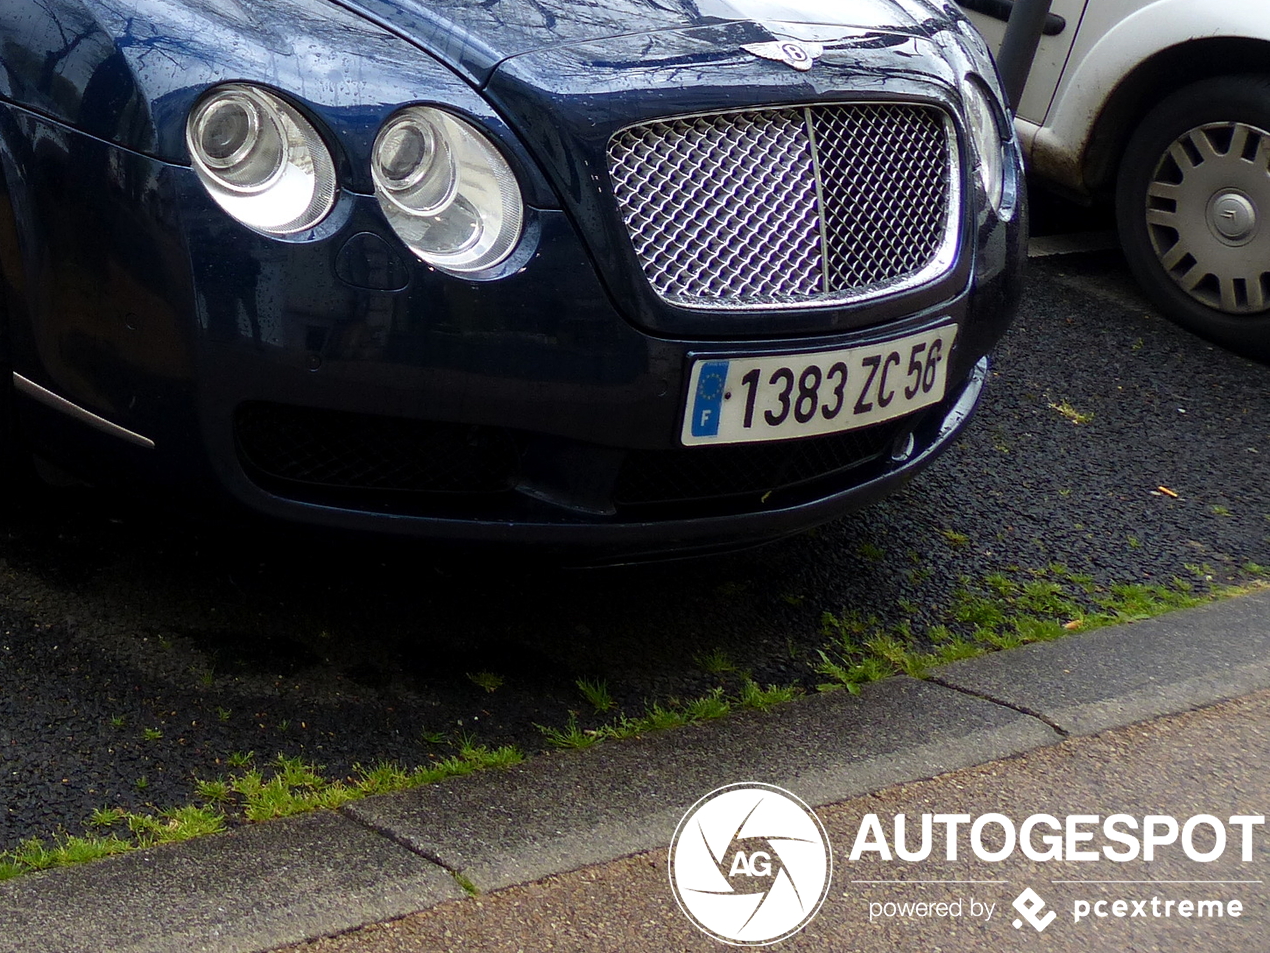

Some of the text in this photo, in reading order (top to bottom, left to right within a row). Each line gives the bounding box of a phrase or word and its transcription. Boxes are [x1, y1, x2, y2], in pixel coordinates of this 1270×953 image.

[700, 338, 943, 429] F 1383 ZC 56
